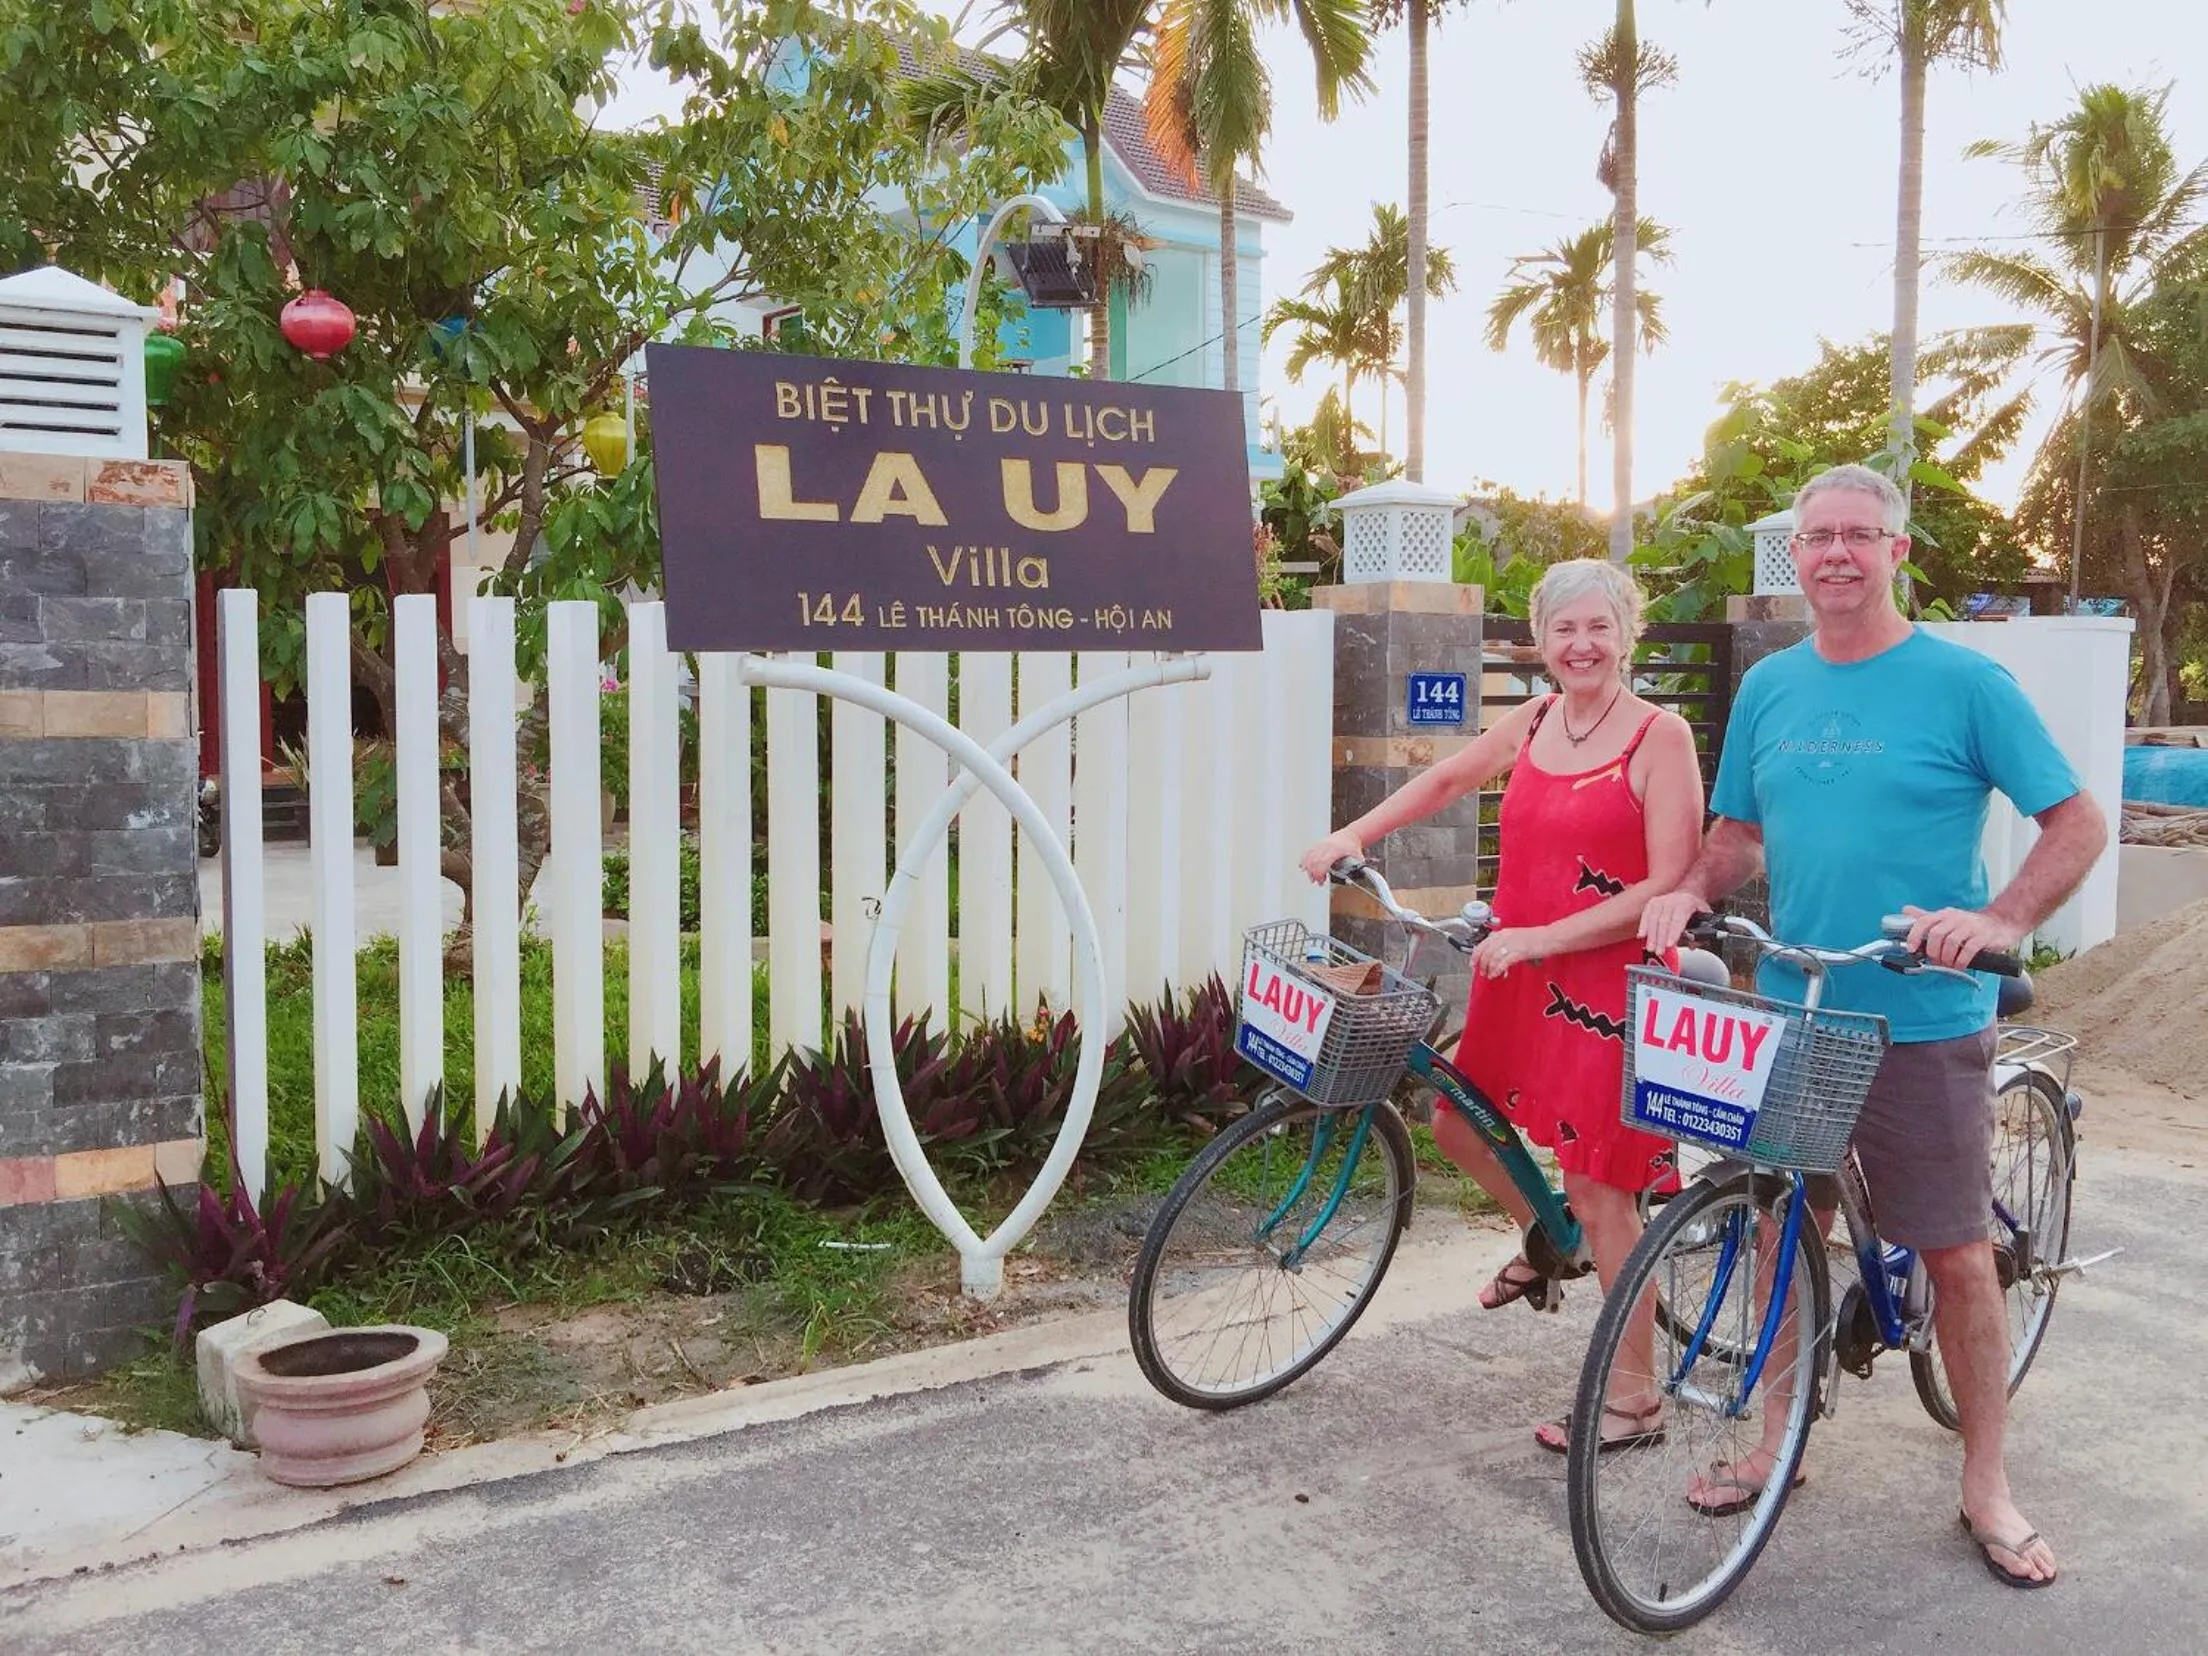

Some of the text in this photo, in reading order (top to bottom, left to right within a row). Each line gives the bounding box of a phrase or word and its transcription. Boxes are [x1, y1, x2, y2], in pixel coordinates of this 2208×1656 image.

[775, 377, 1156, 448] BIỆT THỰ DU LỊCH
[754, 443, 1179, 534] LA UY
[926, 545, 1049, 588] Villa
[797, 592, 865, 627] 144
[878, 599, 908, 628] LÊ
[915, 601, 1001, 629] THÁNH
[1005, 602, 1074, 630] TÔNG
[1094, 603, 1135, 635] HỘI
[1141, 609, 1173, 630] AN
[1416, 681, 1459, 703] 144
[1247, 961, 1326, 1034] LAUY
[1642, 998, 1770, 1072] LAUY
[1645, 1090, 1664, 1118] 144
